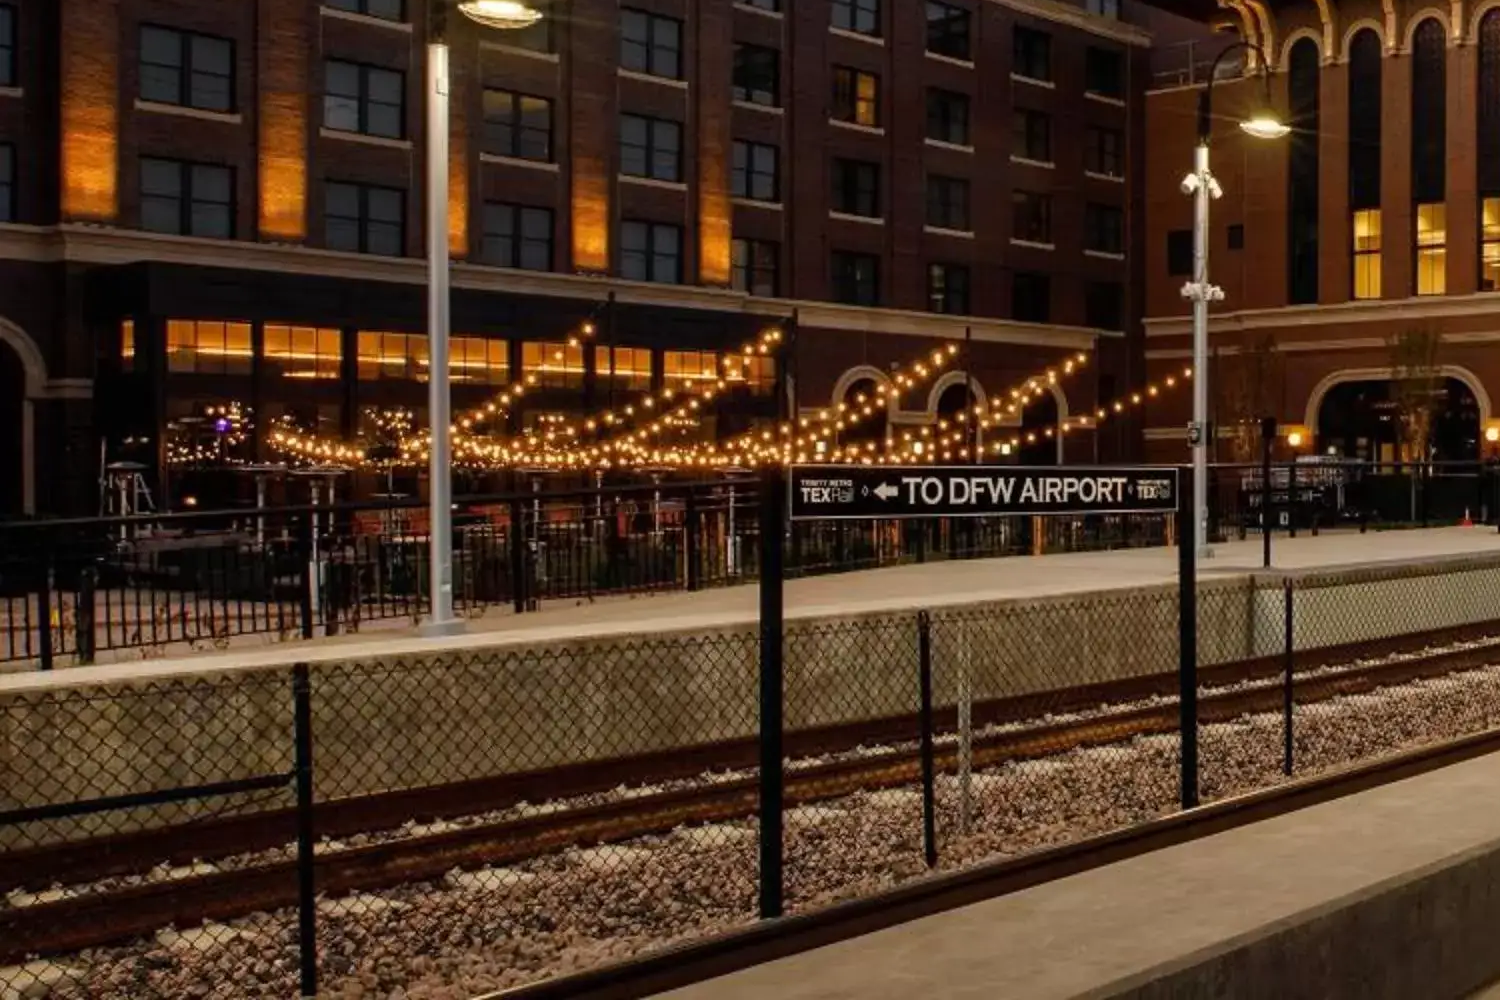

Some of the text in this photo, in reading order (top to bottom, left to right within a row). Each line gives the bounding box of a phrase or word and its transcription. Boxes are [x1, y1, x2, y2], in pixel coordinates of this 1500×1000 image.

[902, 476, 1128, 505] TO DFW AIRPORT
